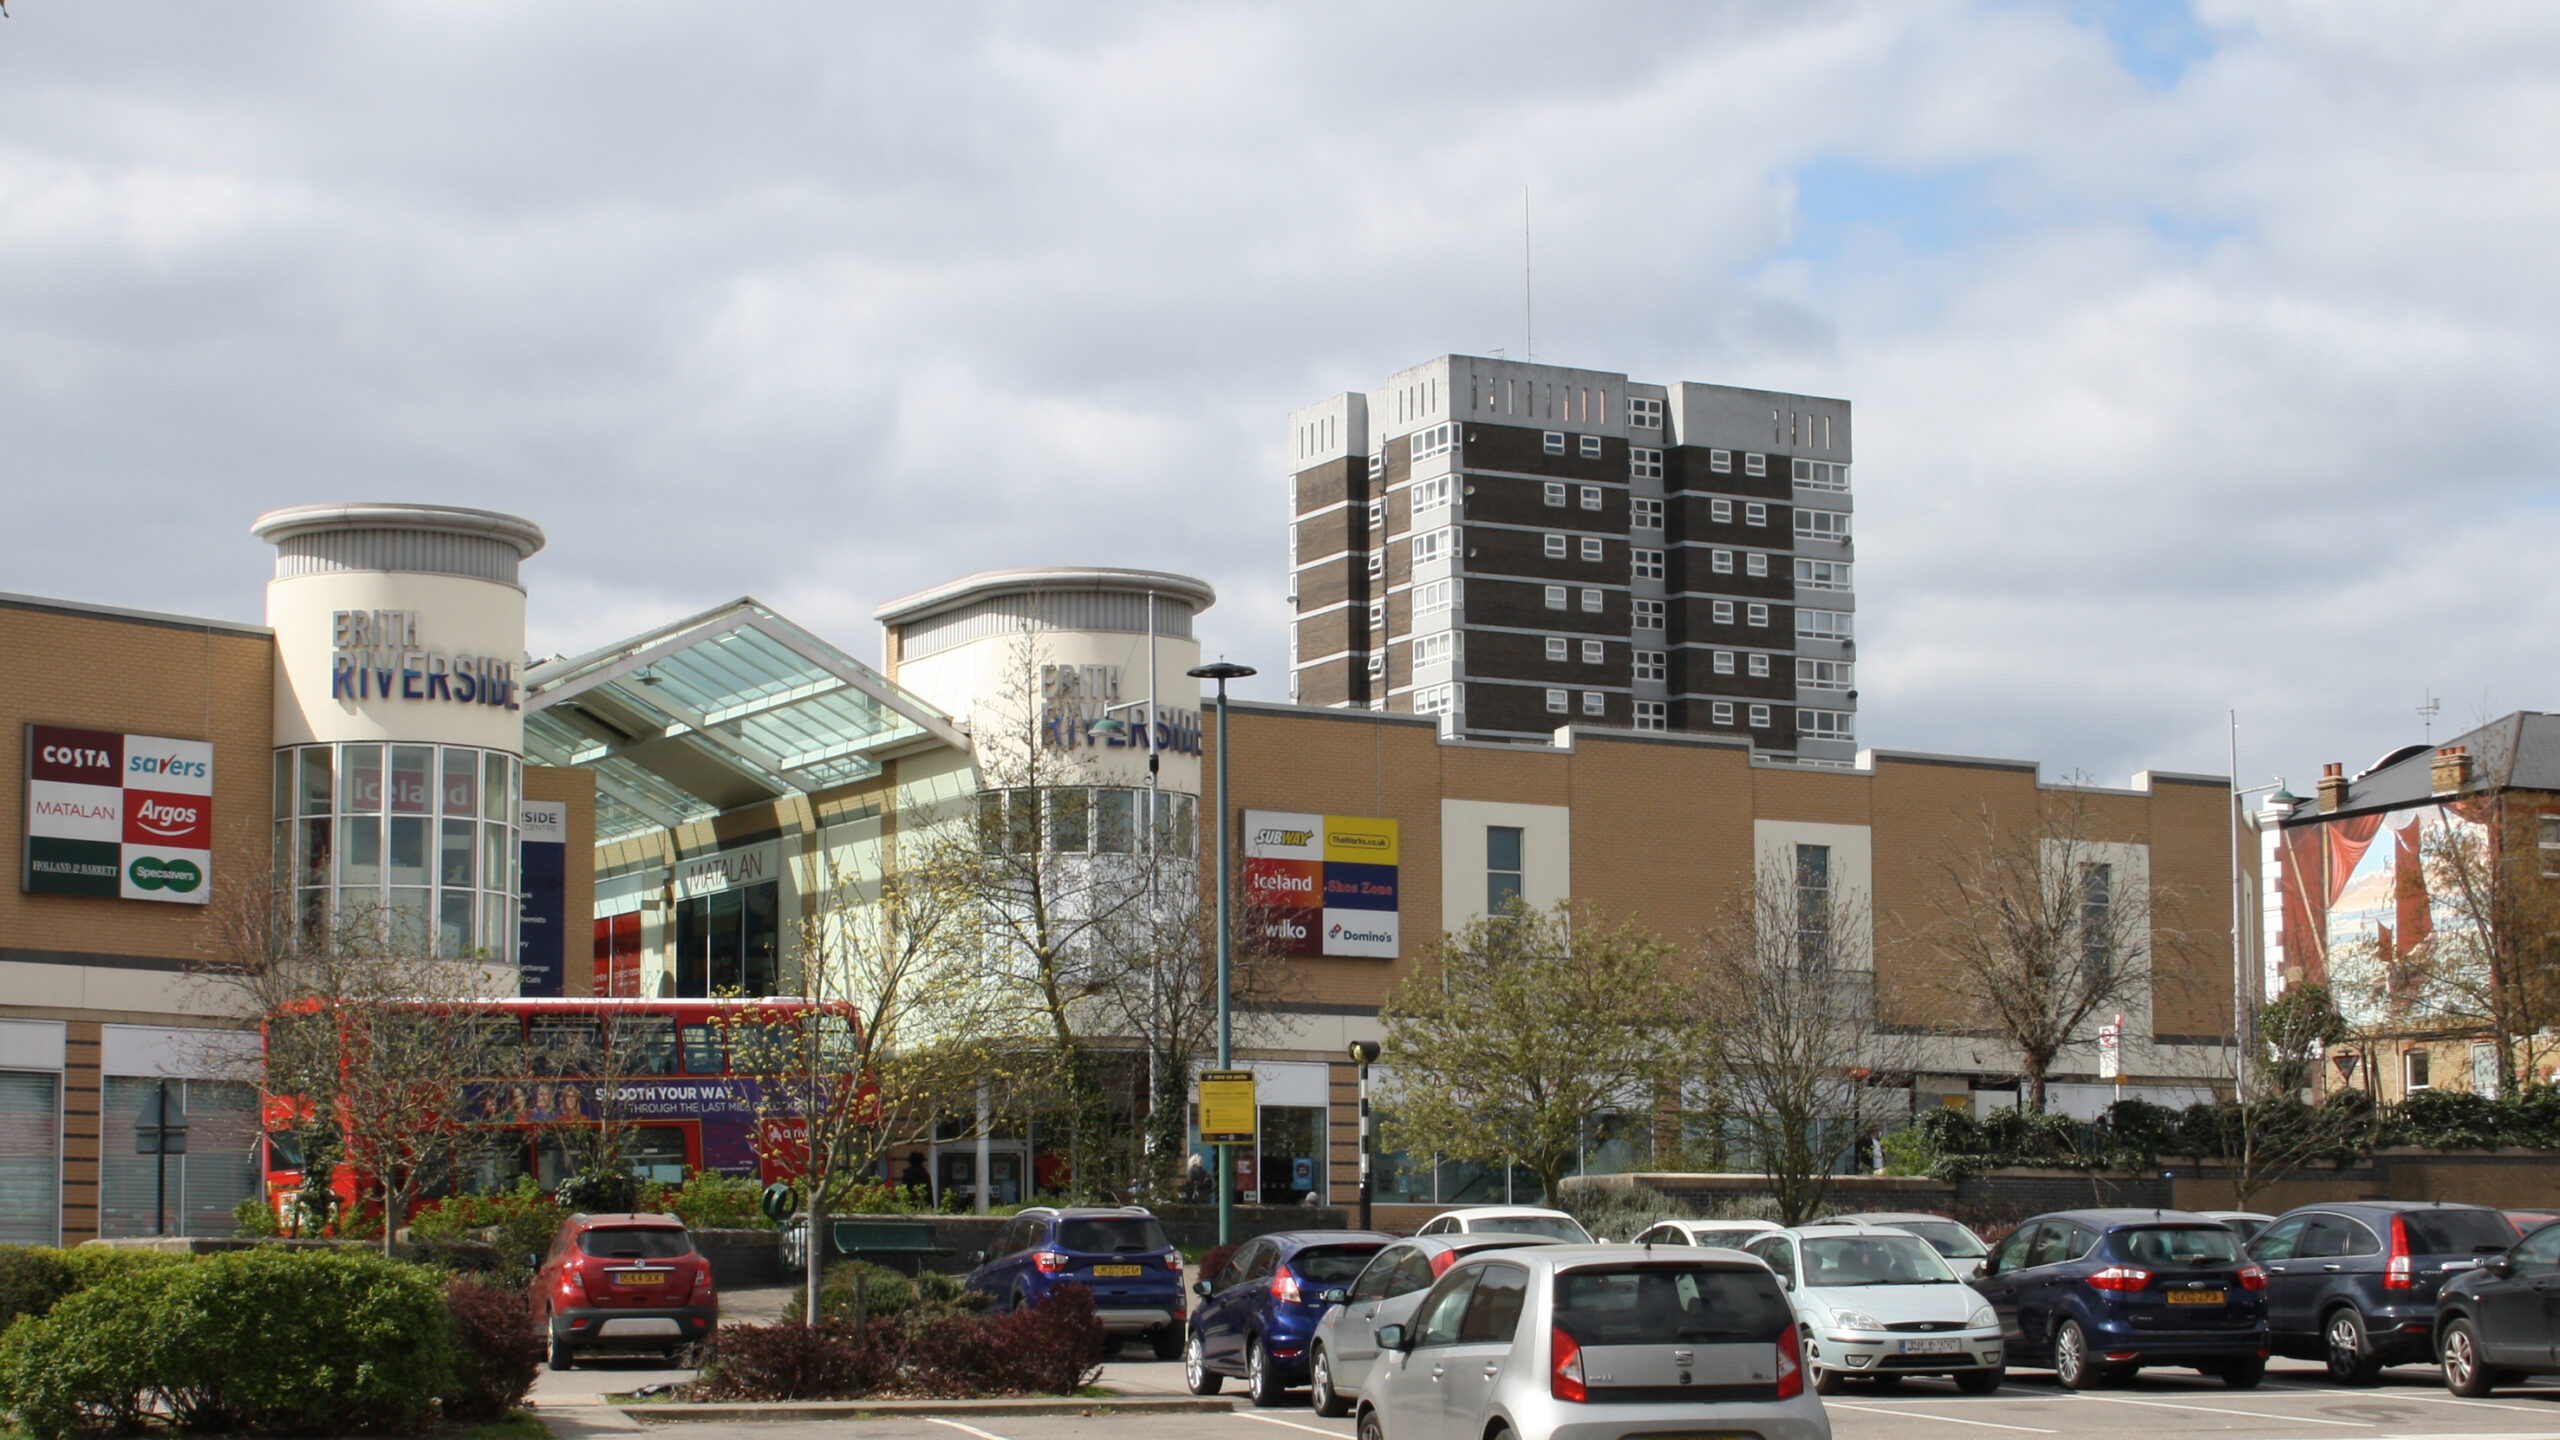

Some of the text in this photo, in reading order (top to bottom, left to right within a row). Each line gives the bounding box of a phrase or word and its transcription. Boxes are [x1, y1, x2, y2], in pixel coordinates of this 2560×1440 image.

[333, 609, 422, 648] ERITH
[332, 650, 520, 711] RIVERSIDE
[1041, 664, 1121, 699] ERITH
[43, 745, 111, 768] COSTA
[129, 753, 206, 778] savers
[36, 800, 116, 820] MATALAN
[137, 799, 197, 827] Argos
[1255, 829, 1314, 846] SUBWAY
[32, 860, 72, 874] HOLLAND
[80, 864, 118, 877] BARRETT
[137, 866, 195, 881] Specsavers
[687, 849, 762, 892] MATALAN
[1254, 873, 1312, 891] Iceland
[1328, 880, 1393, 895] Shoe Zone
[1264, 919, 1307, 939] wilko
[1343, 930, 1392, 943] Domino's
[658, 1087, 697, 1099] YOUR
[700, 1086, 733, 1099] WAY
[680, 1103, 699, 1112] THE
[701, 1102, 726, 1112] LAST
